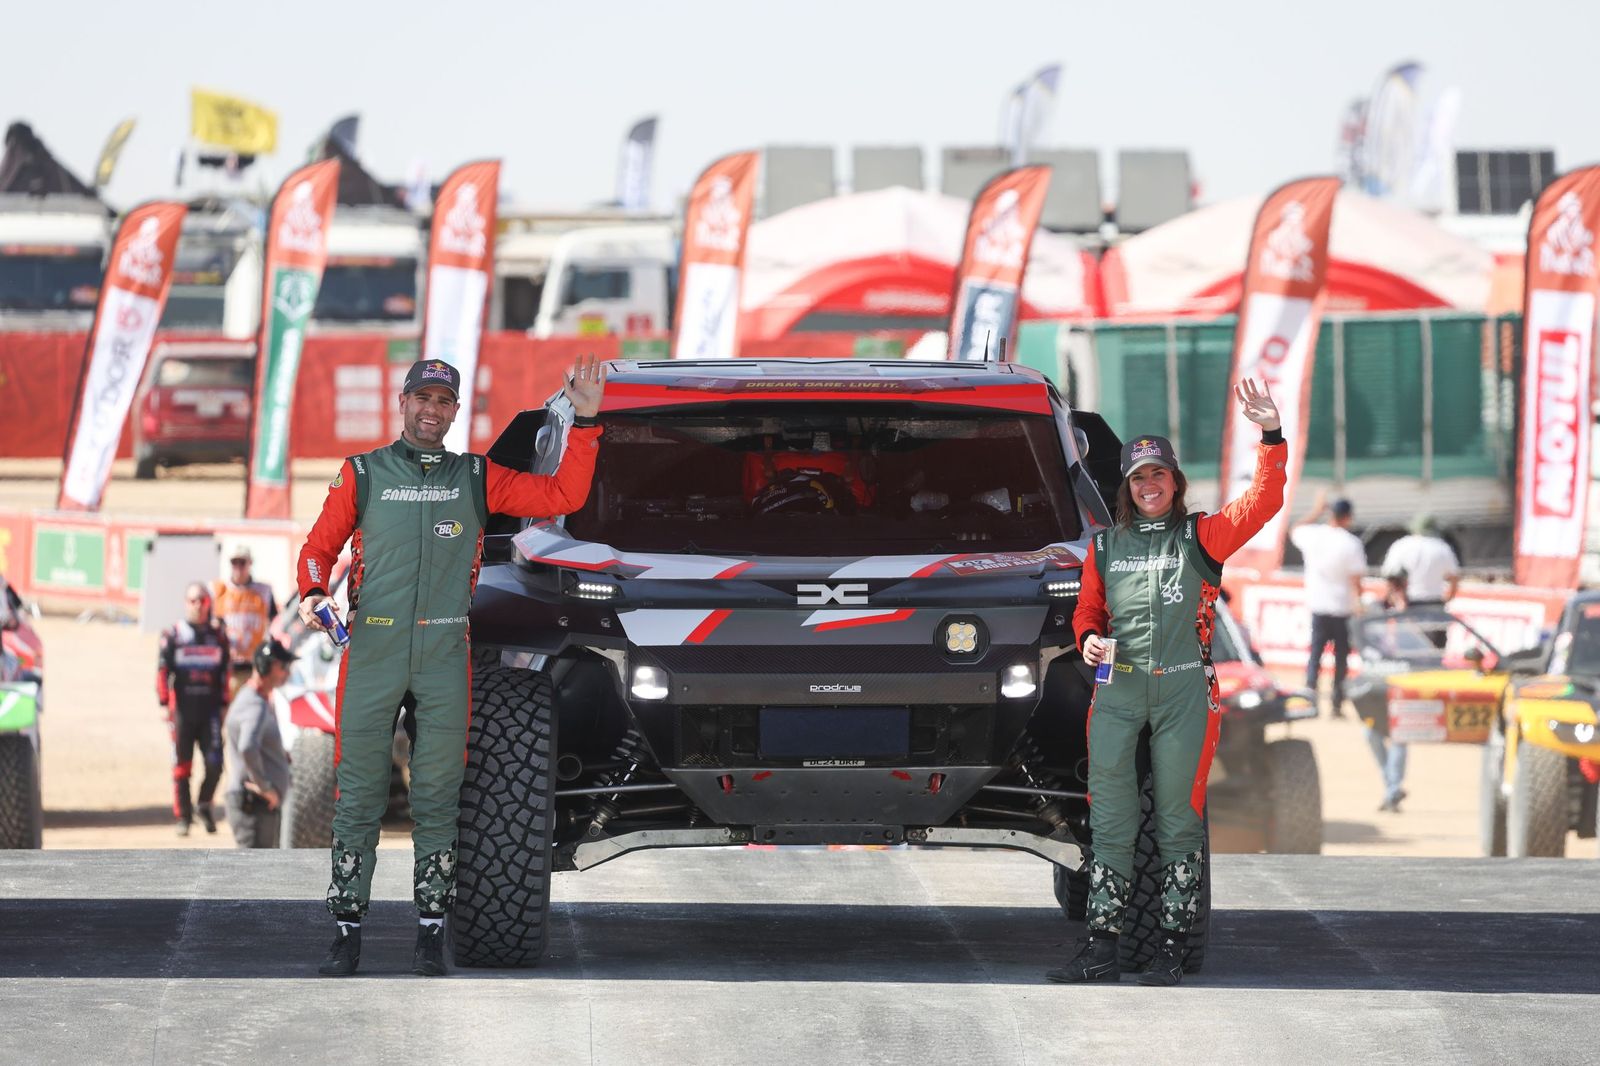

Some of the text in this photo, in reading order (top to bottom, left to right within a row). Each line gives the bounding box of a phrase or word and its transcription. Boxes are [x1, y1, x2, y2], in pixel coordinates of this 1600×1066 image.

[422, 370, 453, 383] Red Bull
[745, 381, 801, 389] DREAM.
[804, 381, 846, 389] DARE.
[849, 381, 882, 389] LIVE
[1131, 447, 1162, 461] Red Bull
[431, 617, 454, 626] MORENO
[809, 683, 862, 693] prodrive
[1453, 704, 1493, 728] 232
